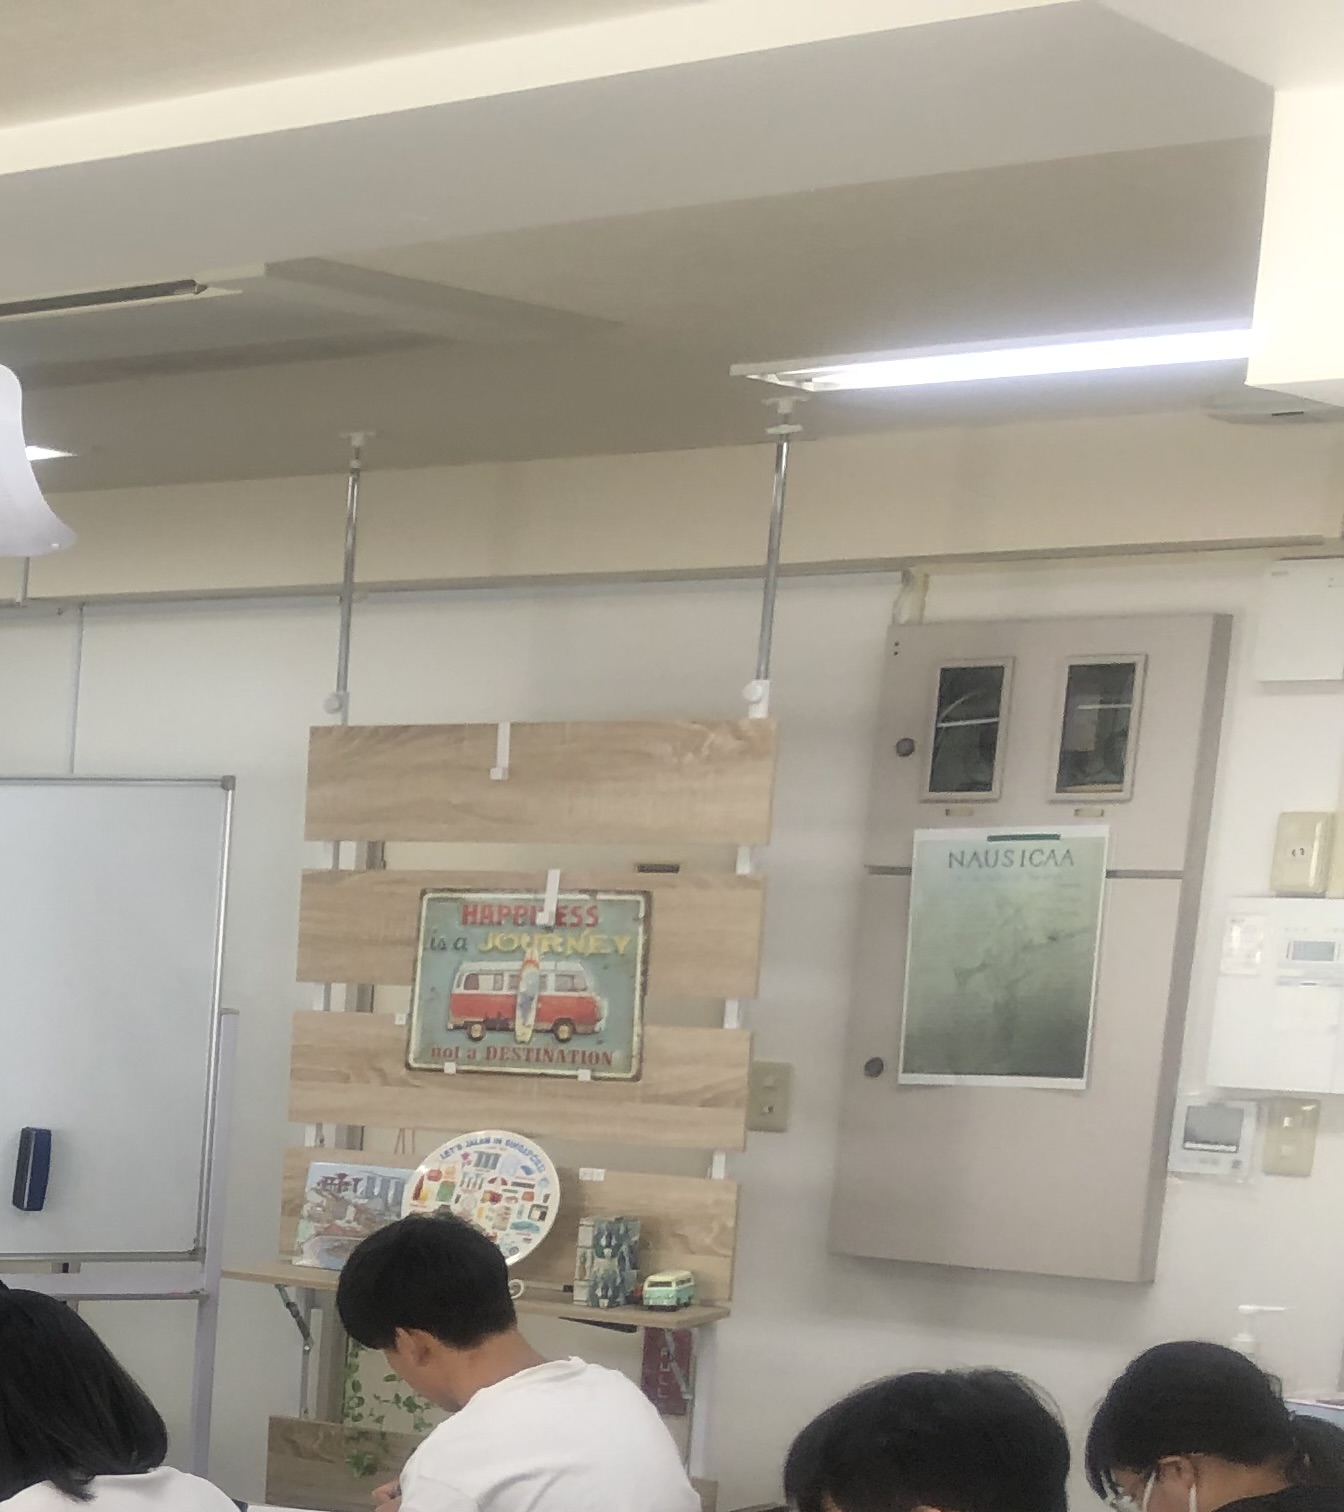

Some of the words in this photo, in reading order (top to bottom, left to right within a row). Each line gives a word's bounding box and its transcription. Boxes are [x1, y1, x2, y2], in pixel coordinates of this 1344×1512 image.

[948, 848, 1074, 869] NAUSICAA
[460, 902, 599, 927] HAPPIESS
[430, 935, 447, 951] is
[453, 936, 468, 951] a
[478, 932, 632, 956] JOURNEY
[431, 1045, 459, 1060] not
[467, 1049, 477, 1060] a
[485, 1046, 613, 1066] DESTINATION
